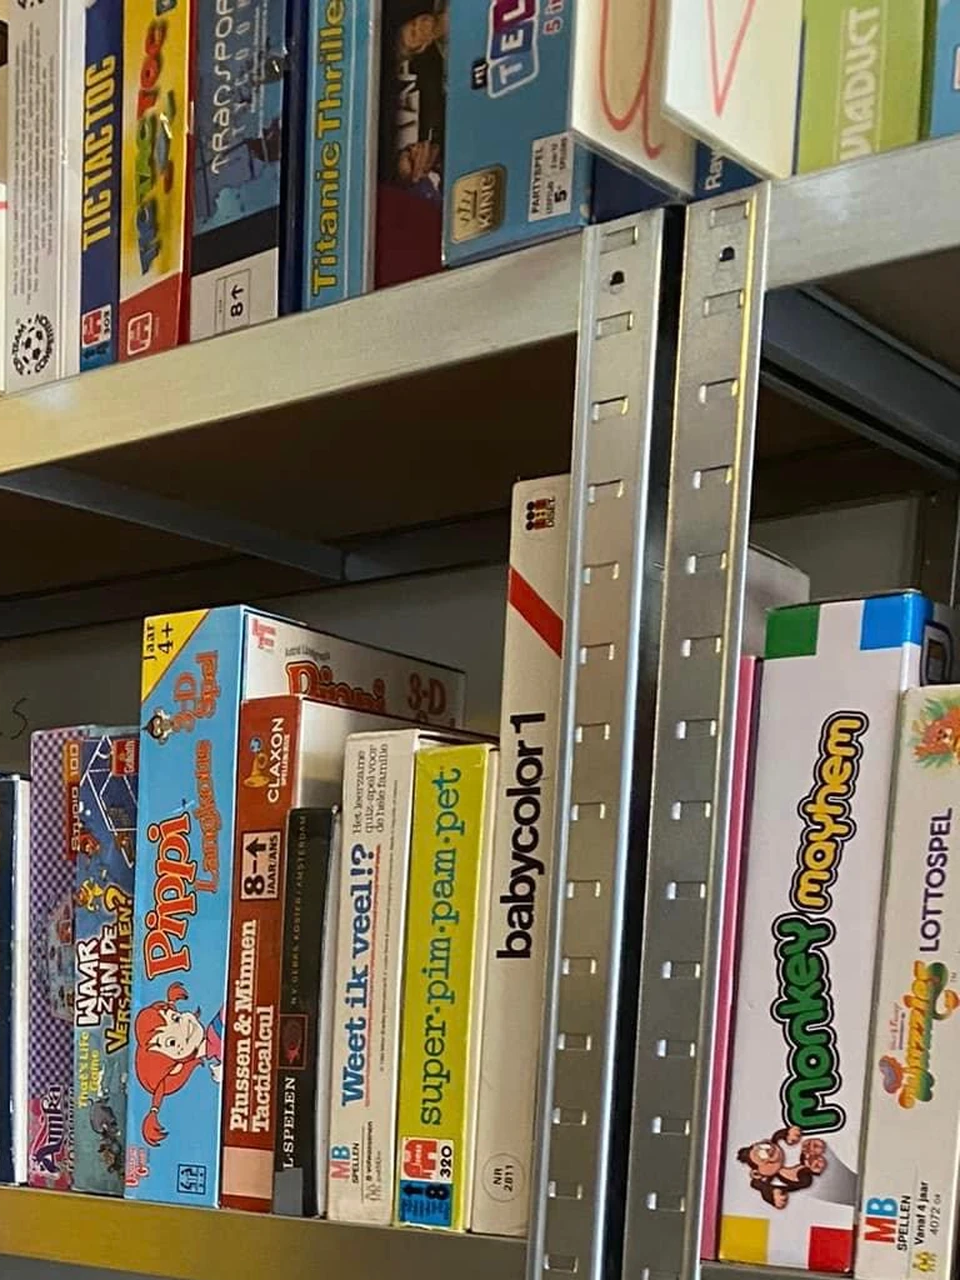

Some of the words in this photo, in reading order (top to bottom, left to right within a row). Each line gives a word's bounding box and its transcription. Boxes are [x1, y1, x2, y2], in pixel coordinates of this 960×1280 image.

[707, 0, 756, 118] V
[85, 123, 114, 195] TAC
[531, 149, 544, 214] PARTYSPEL
[83, 189, 112, 252] TIC
[312, 141, 341, 298] Titanic
[480, 172, 497, 230] KING
[510, 711, 546, 723] 1
[69, 744, 79, 773] 100
[268, 717, 284, 803] CLAXON
[353, 750, 366, 808] leerzame
[369, 744, 378, 773] voor
[377, 743, 389, 790] familie
[70, 784, 80, 851] STUDIO
[194, 739, 224, 895] Langkous
[352, 810, 361, 834] Het
[364, 773, 377, 835] quiz-spel
[789, 710, 869, 913] mayhem
[266, 834, 279, 895] JAAR/ANS
[496, 738, 546, 959] babycolor
[145, 812, 193, 979] Pippi
[919, 807, 954, 954] LOTTOSPEL
[101, 925, 118, 956] DE
[235, 918, 257, 1014] Minnen
[77, 939, 99, 1027] WAAR
[98, 963, 115, 1014] ZIJN
[106, 884, 135, 1056] VERSCHILLEN?
[346, 963, 369, 1009] ik
[79, 1030, 89, 1067] Life
[234, 1014, 252, 1036] &
[773, 912, 845, 1135] monkey
[79, 1070, 89, 1108] That's
[90, 1050, 100, 1092] Game
[230, 1039, 251, 1133] Plussen
[251, 1004, 274, 1133] Tacticalcul
[342, 1016, 367, 1108] Weet
[330, 1143, 352, 1181] MB
[351, 1141, 360, 1184] SPELLEN
[439, 1144, 453, 1179] 320
[919, 1179, 930, 1201] jaar
[864, 1195, 899, 1245] MB
[897, 1194, 911, 1252] SPELLEN
[913, 1213, 927, 1246] Vanaf
[929, 1208, 941, 1237] 4072
